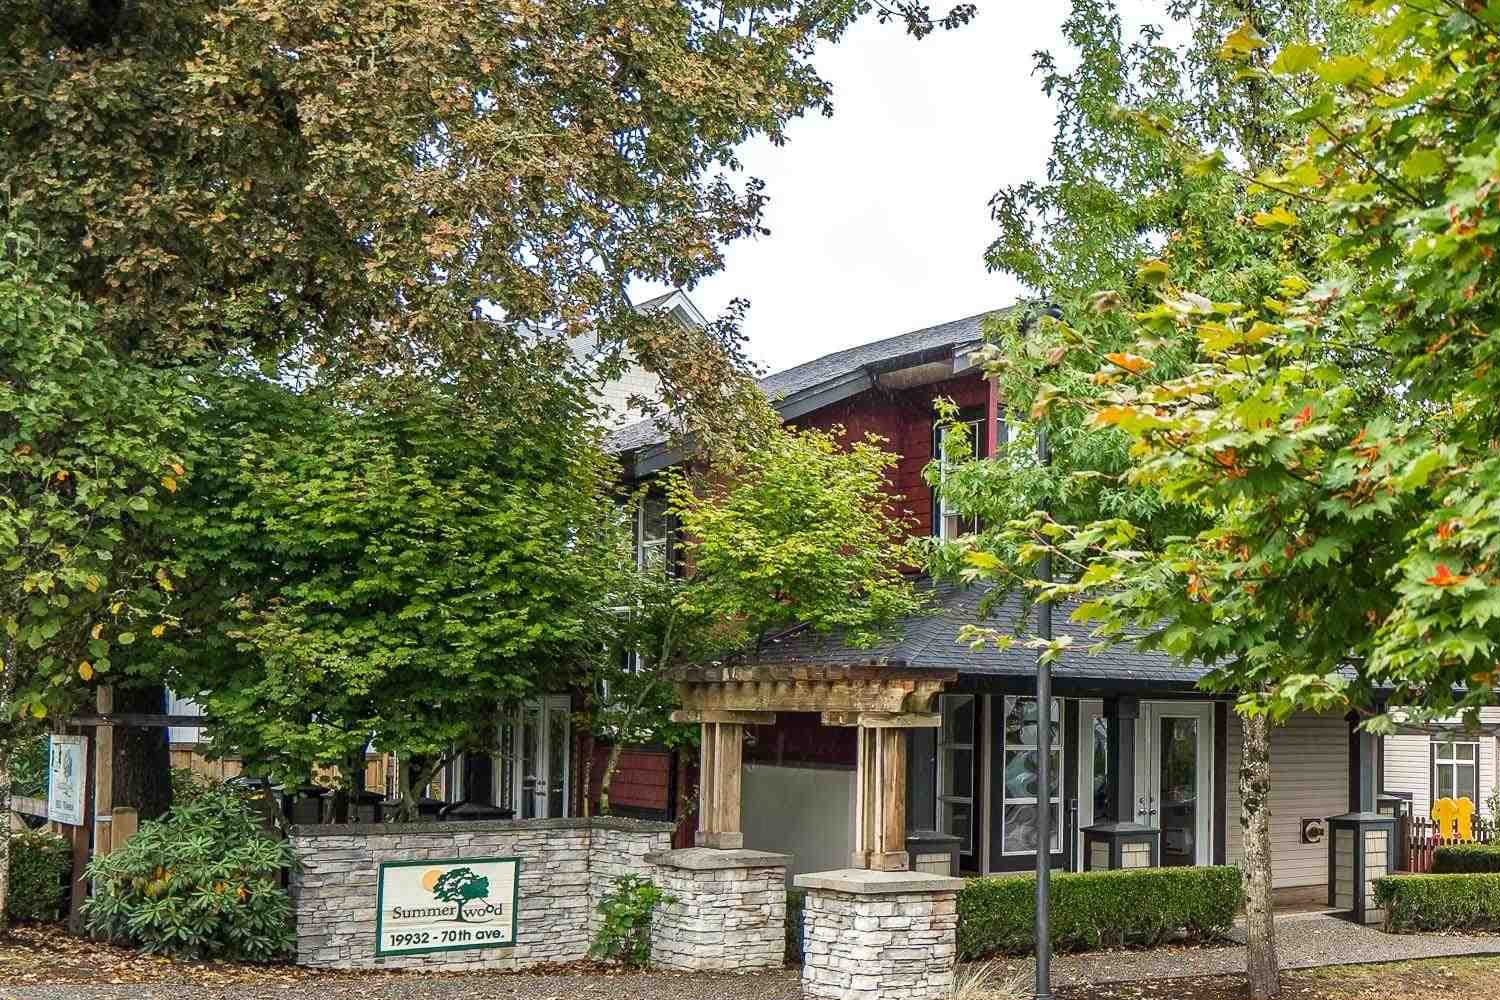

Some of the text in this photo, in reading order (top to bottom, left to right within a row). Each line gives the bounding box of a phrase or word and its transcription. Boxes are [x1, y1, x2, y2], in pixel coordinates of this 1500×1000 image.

[390, 932, 430, 946] 19932
[441, 929, 472, 943] 70th
[475, 929, 505, 940] ave.
